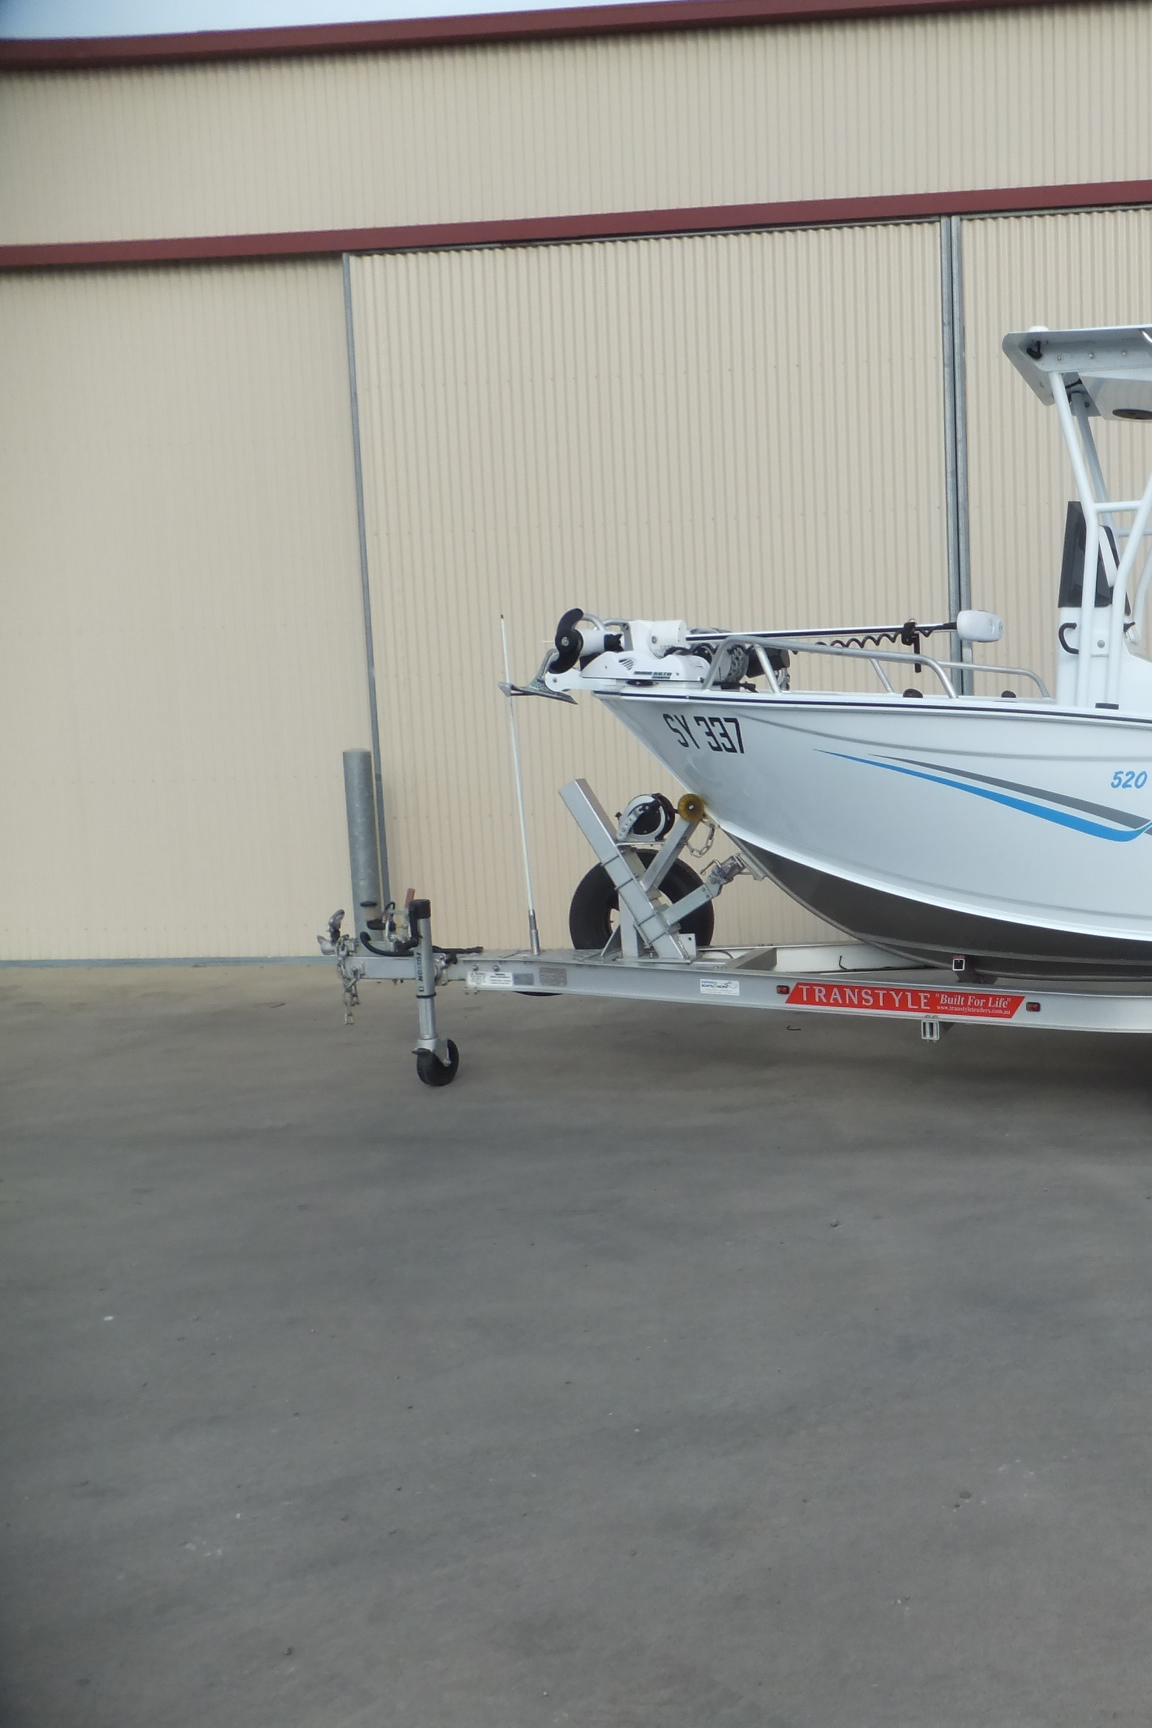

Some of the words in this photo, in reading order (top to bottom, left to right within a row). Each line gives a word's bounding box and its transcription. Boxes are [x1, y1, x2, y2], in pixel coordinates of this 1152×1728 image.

[662, 713, 700, 749] SY
[694, 716, 745, 754] 337
[1110, 770, 1148, 789] 520
[797, 985, 931, 1010] TRANSTYLE
[967, 995, 986, 1007] For
